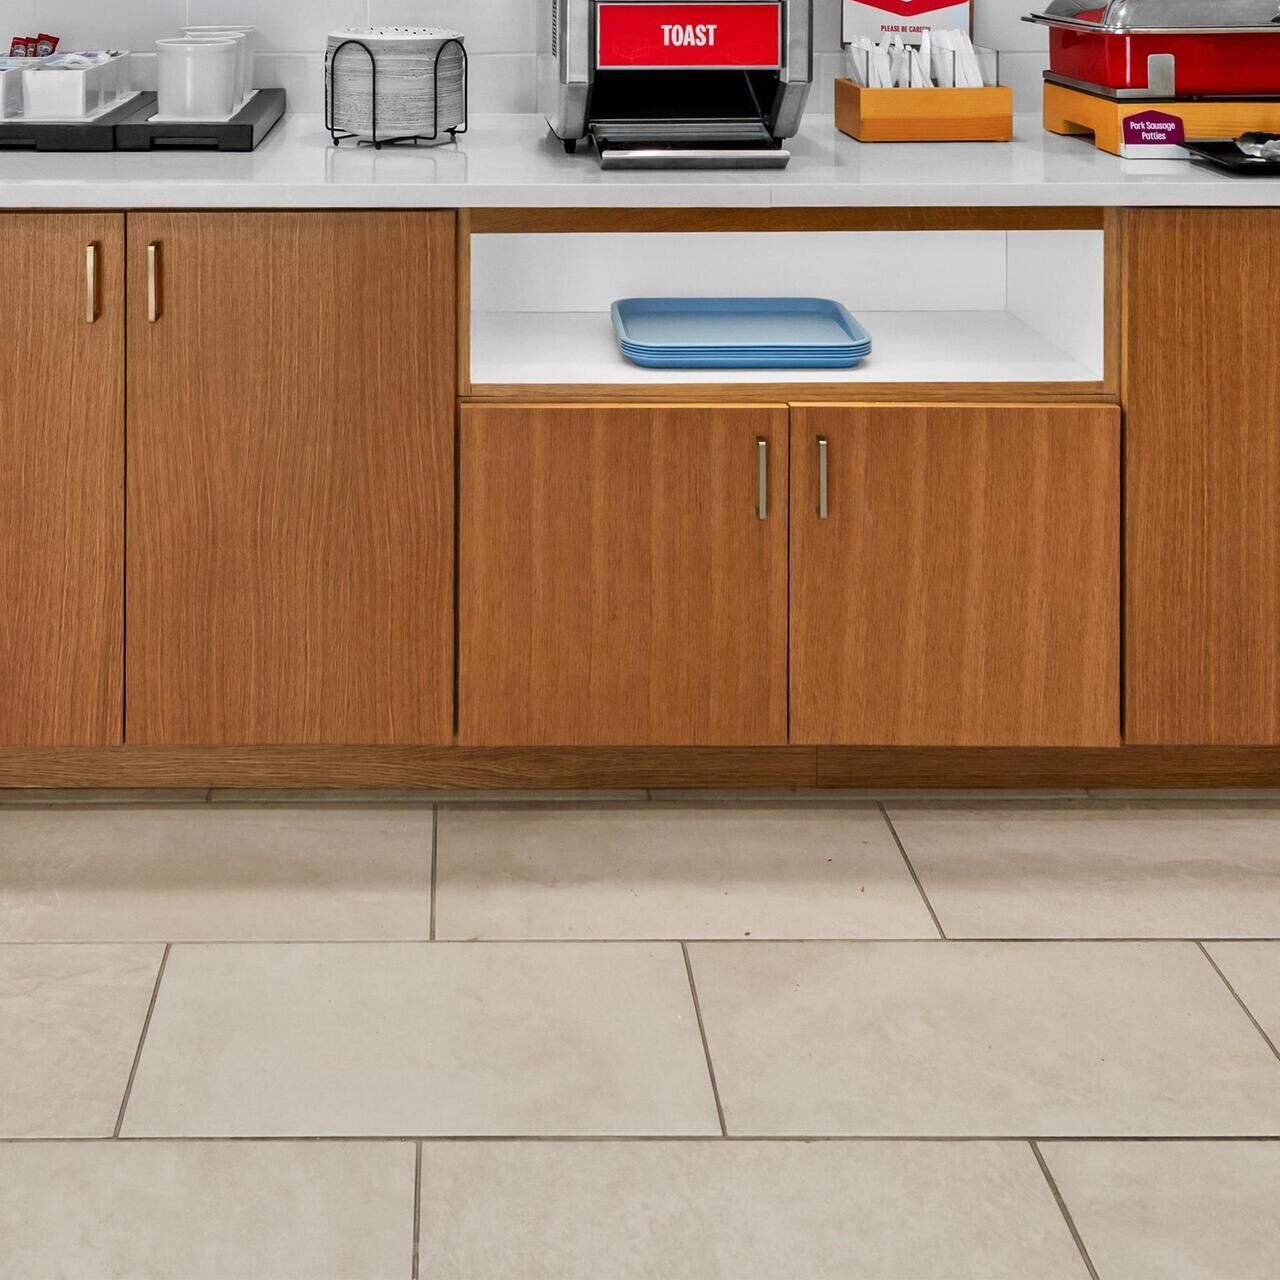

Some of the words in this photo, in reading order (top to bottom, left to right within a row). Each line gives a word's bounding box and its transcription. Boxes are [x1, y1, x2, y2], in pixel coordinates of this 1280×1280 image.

[880, 25, 900, 33] PLEASE
[901, 25, 909, 33] BE
[660, 24, 718, 47] TOAST
[1130, 121, 1145, 130] Pork
[1145, 121, 1176, 132] Sausage
[1141, 131, 1167, 140] Patties
